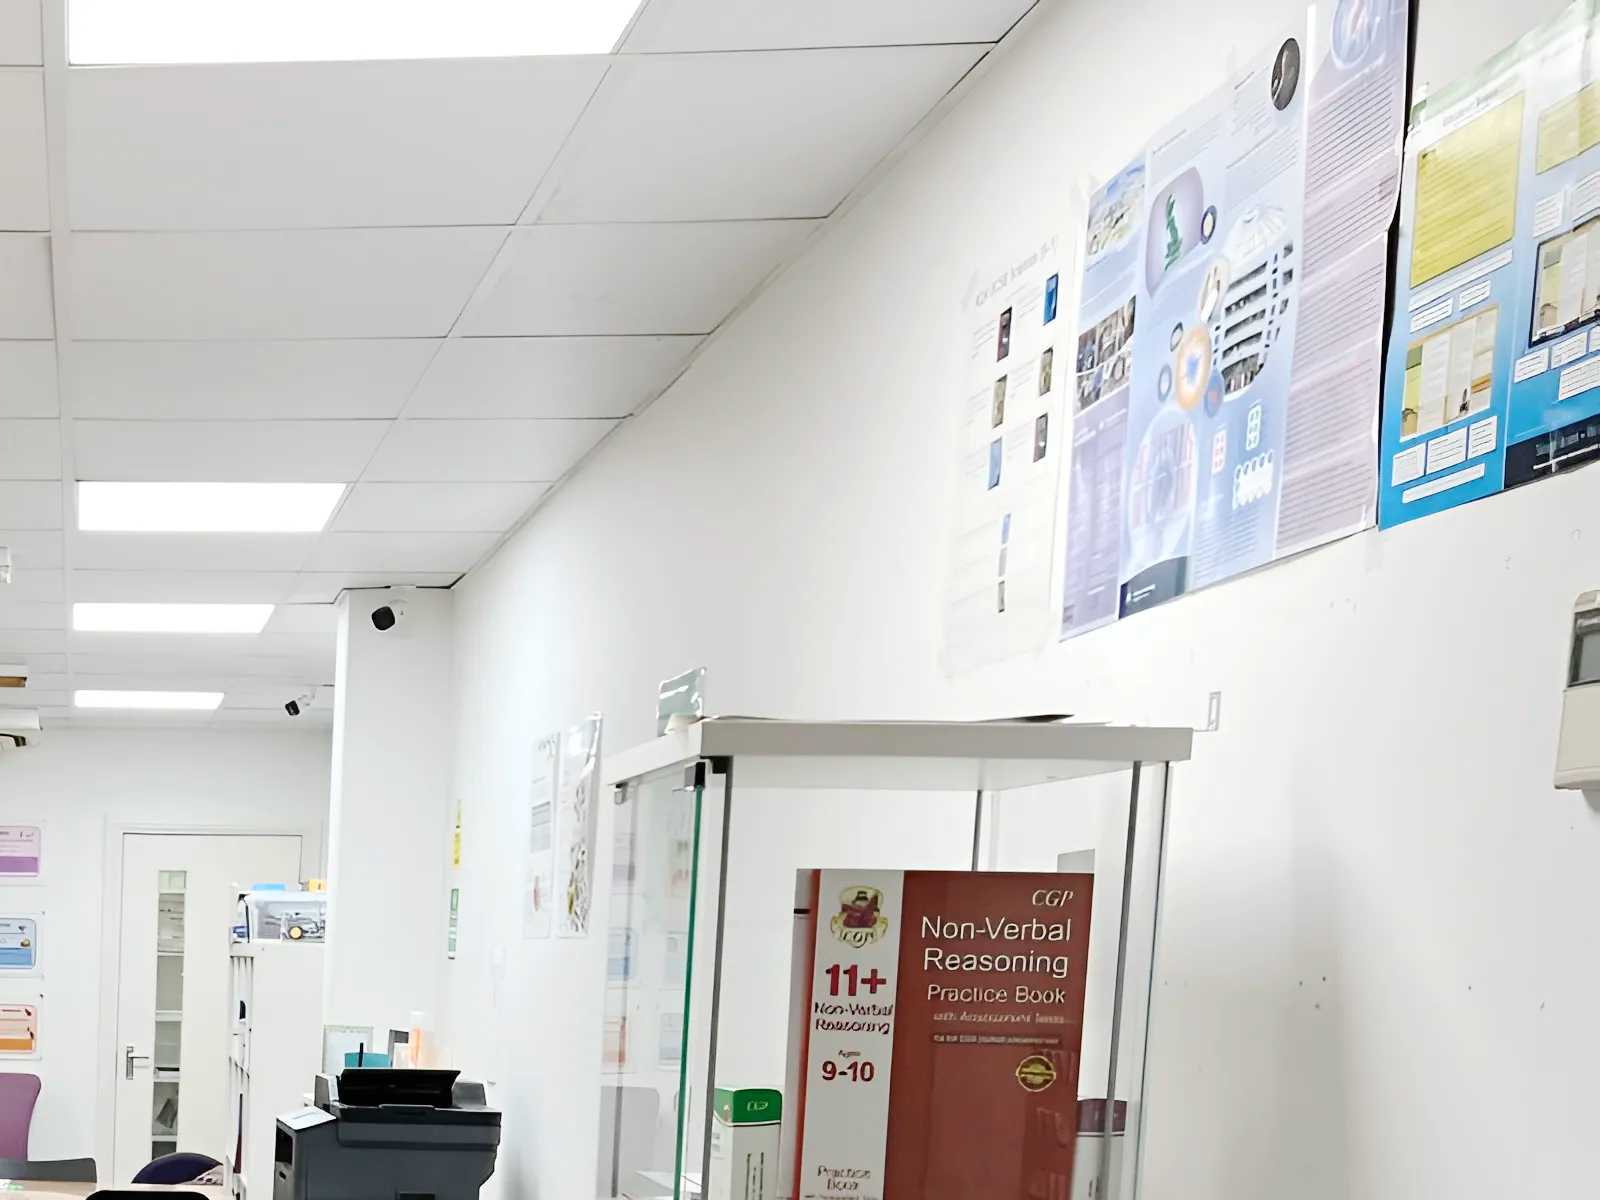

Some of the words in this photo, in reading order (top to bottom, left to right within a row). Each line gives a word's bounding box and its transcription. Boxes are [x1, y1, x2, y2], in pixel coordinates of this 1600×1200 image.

[1032, 889, 1074, 907] CGP
[921, 915, 1072, 941] Non-Verbal
[923, 947, 1069, 978] Reasoning
[825, 964, 887, 996] 11+
[927, 984, 1008, 1003] Practice
[1015, 985, 1066, 1004] Book
[814, 1002, 893, 1016] Non-Verbal
[815, 1018, 890, 1035] Reasoning
[821, 1061, 875, 1082] 9-10
